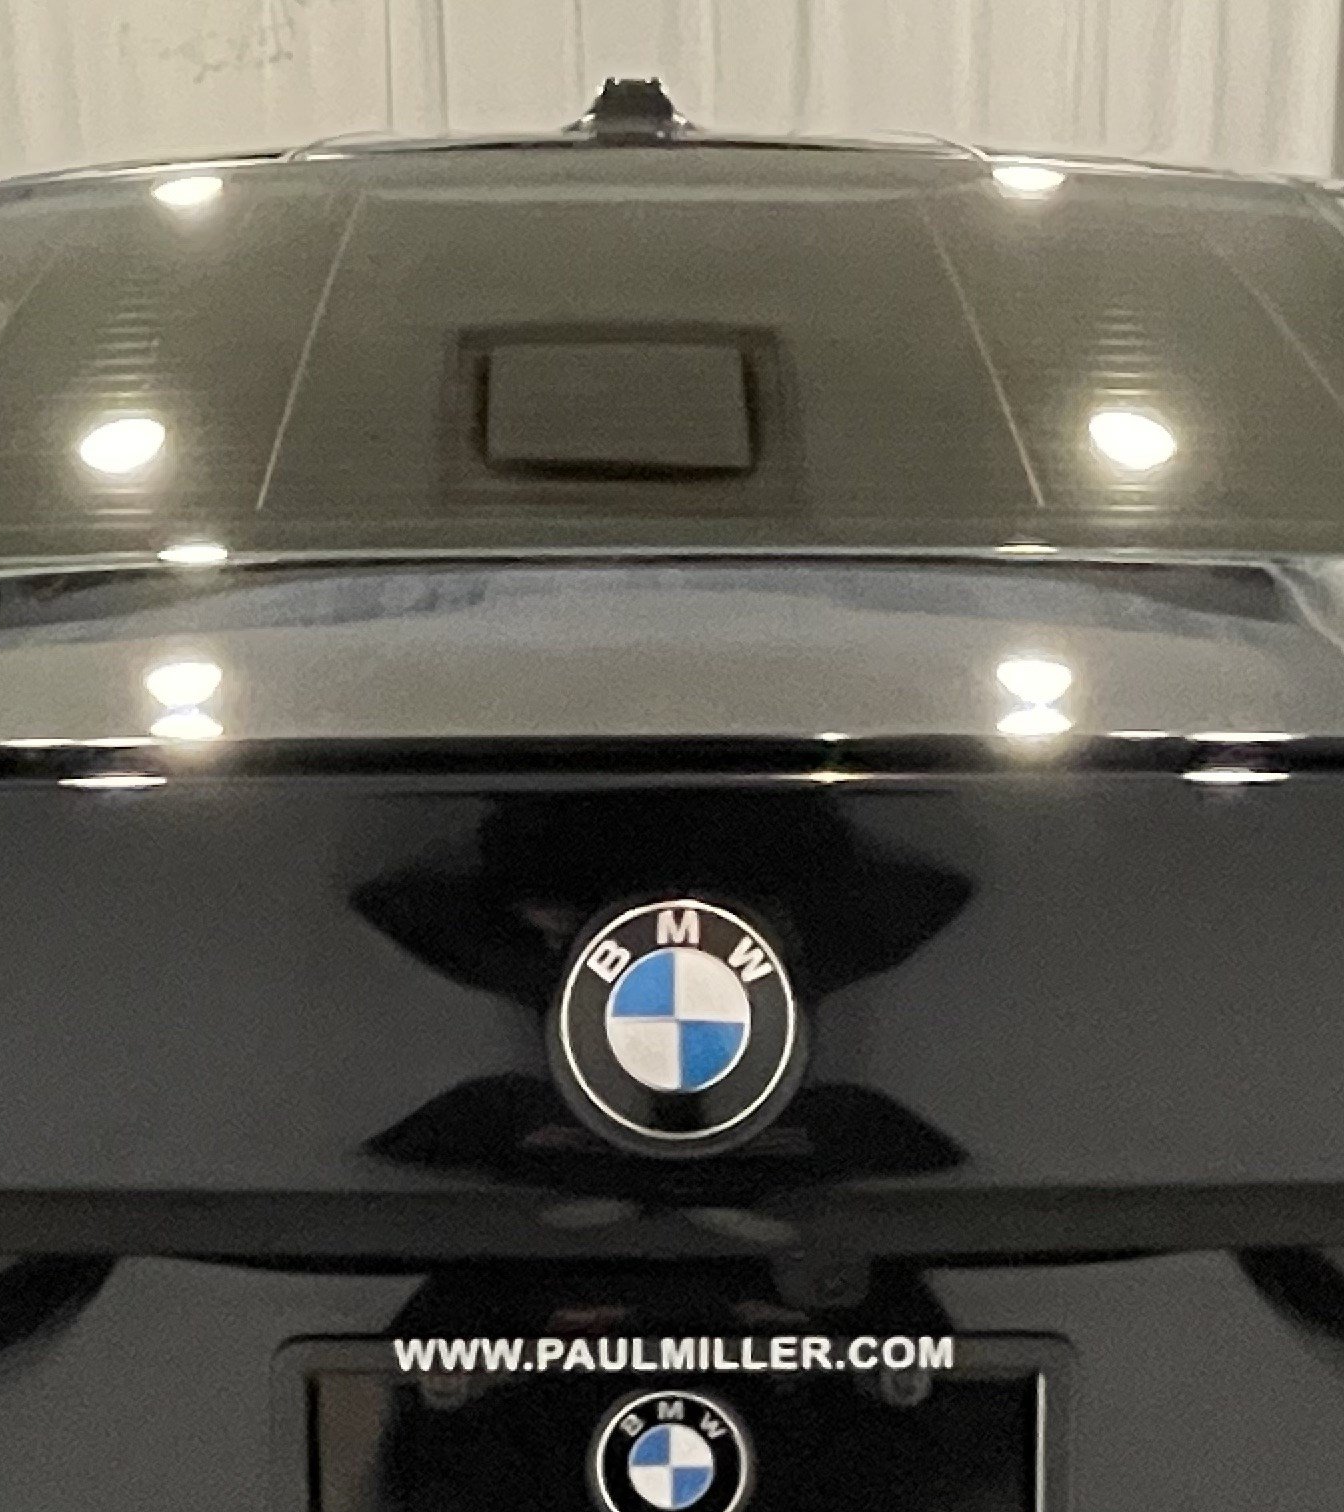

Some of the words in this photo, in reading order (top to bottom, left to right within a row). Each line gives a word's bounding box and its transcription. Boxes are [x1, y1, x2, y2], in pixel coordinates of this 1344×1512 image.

[586, 909, 773, 984] BMW
[393, 1335, 954, 1372] WWW.PAULMILLER.COM
[619, 1399, 728, 1441] BMW
